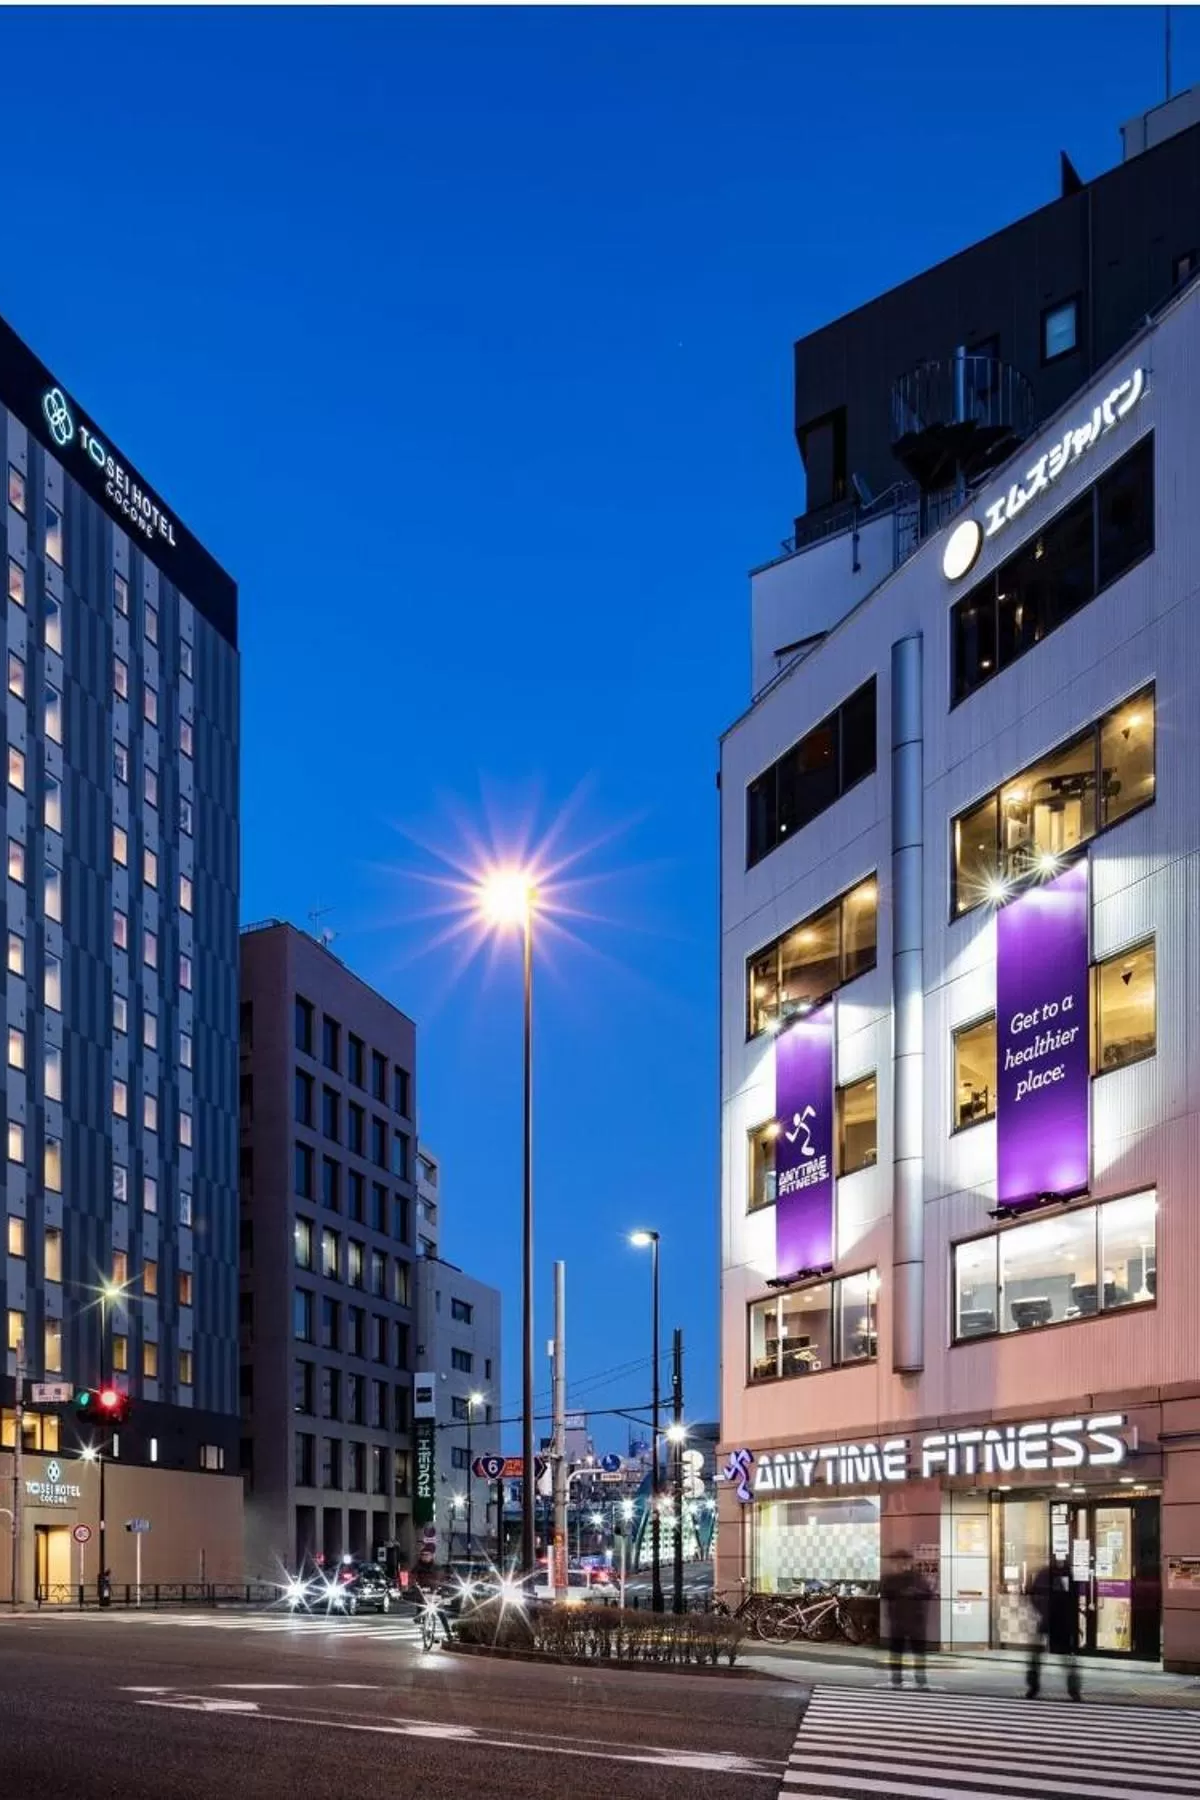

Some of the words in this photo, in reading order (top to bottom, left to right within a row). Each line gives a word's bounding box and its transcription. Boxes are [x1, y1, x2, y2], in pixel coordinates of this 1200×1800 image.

[985, 367, 1143, 537] エムスジャパン
[78, 424, 130, 496] TOSEI
[131, 483, 177, 547] HOTEL
[106, 481, 153, 539] COCONE
[1010, 1008, 1040, 1035] Get
[1042, 1002, 1059, 1021] to
[1061, 994, 1074, 1012] a
[1004, 1026, 1080, 1072] healthier
[778, 1154, 827, 1186] ANYTIME
[487, 1459, 499, 1474] 6
[754, 1438, 910, 1492] ANYTIME
[920, 1414, 1125, 1479] FITNESS
[25, 1480, 54, 1496] TOSEI
[54, 1483, 81, 1498] HOTEL
